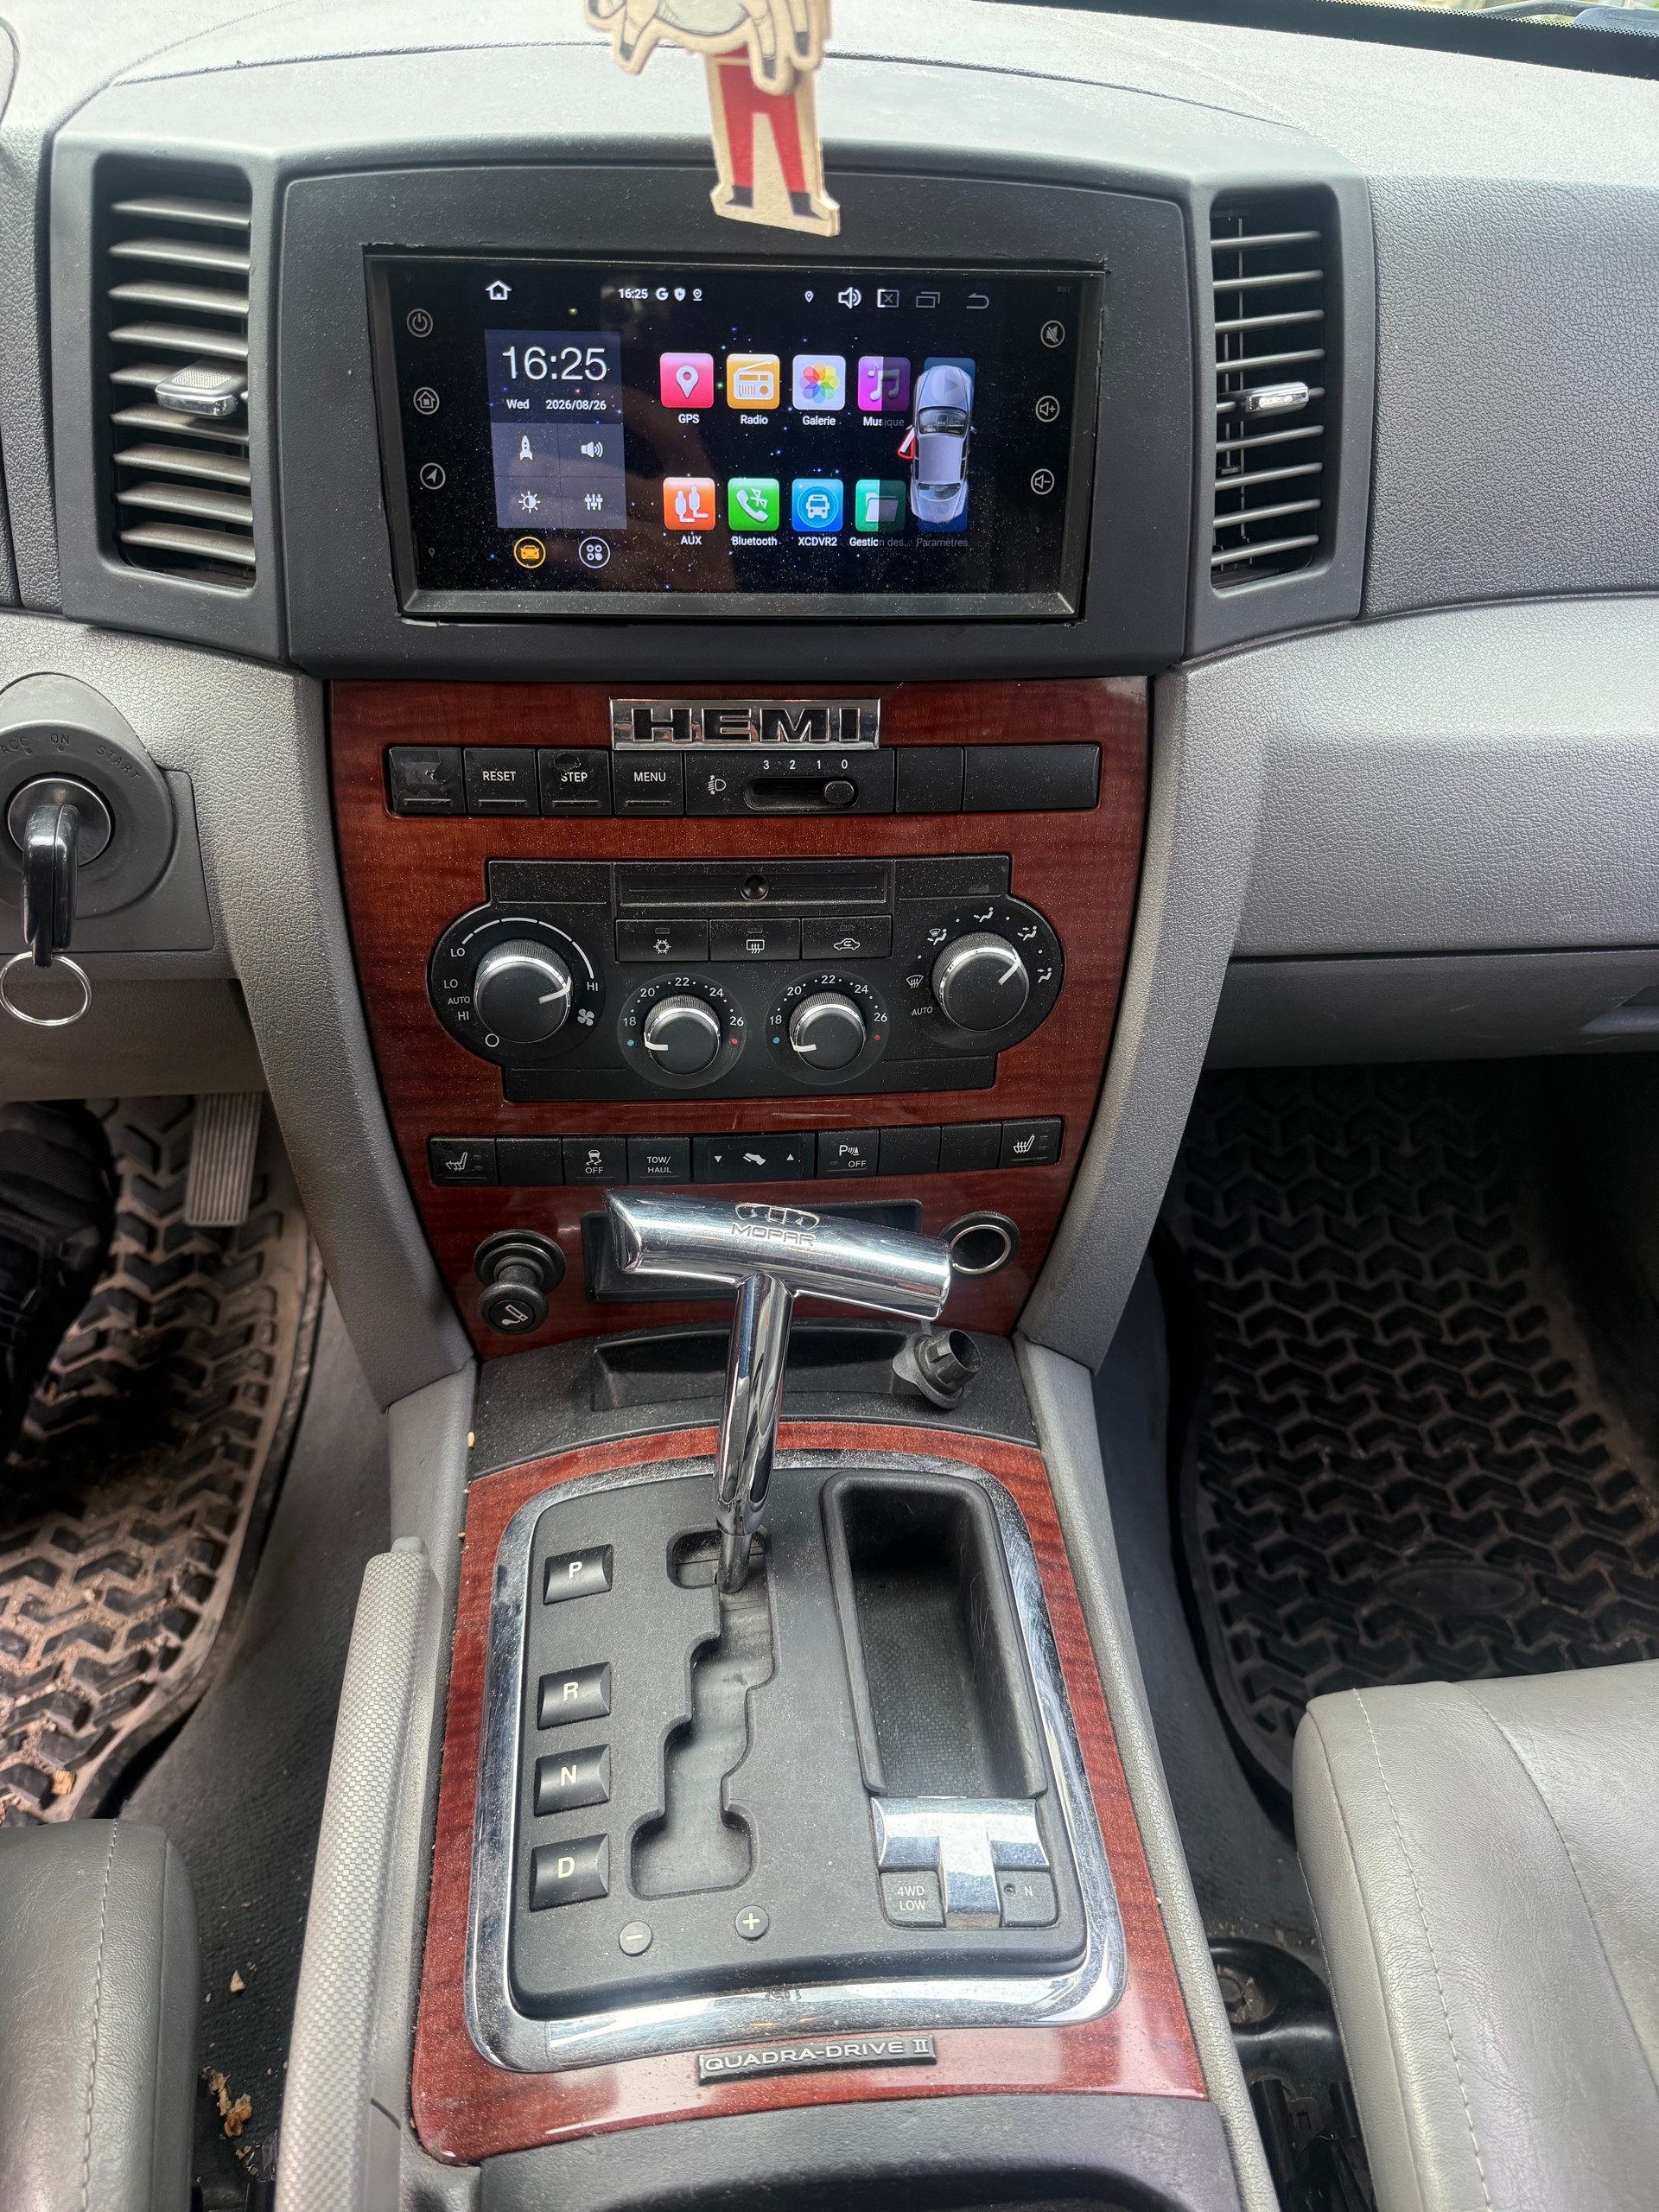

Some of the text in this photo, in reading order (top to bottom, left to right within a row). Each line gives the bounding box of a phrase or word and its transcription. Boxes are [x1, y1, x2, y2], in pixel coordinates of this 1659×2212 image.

[619, 289, 649, 300] 16:25
[502, 346, 607, 381] 16:25
[506, 399, 607, 411] Wed 2026/08/26
[678, 414, 700, 424] GPS
[741, 415, 768, 425] Radio
[802, 416, 836, 426] Galerie
[681, 535, 702, 545] AUX
[732, 536, 778, 546] Bluetooth
[798, 536, 837, 547] XCDVR2
[631, 708, 861, 743] HEMI
[50, 734, 70, 745] ON
[0, 736, 29, 756] ACC
[96, 745, 141, 779] START
[763, 759, 849, 770] 3 2 1 0
[482, 771, 517, 782] RESET
[561, 772, 588, 783] STEP
[633, 772, 666, 782] MENU
[450, 947, 466, 957] LO
[443, 979, 459, 988] LO
[675, 977, 690, 987] 22
[821, 975, 836, 984] 22
[587, 982, 599, 992] HI
[787, 986, 802, 996] 20
[854, 984, 869, 995] 24
[640, 988, 655, 998] 20
[709, 988, 724, 998] 24
[448, 995, 471, 1005] AUTO
[458, 1011, 470, 1020] HI
[911, 1006, 933, 1016] AUTO
[623, 1016, 637, 1027] 18
[729, 1016, 745, 1027] 26
[769, 1015, 783, 1026] 18
[874, 1013, 888, 1023] 26
[647, 1155, 671, 1165] TOW/
[848, 1160, 867, 1169] OFF
[730, 1222, 817, 1247] MOPAR
[569, 1562, 583, 1579] P
[563, 1681, 579, 1700] R
[560, 1765, 577, 1785] N
[557, 1857, 575, 1878] D
[897, 1886, 925, 1897] 4WD
[1024, 1886, 1033, 1897] N
[899, 1900, 925, 1910] LOW
[705, 2038, 929, 2071] QUADRA-DRIVE II
